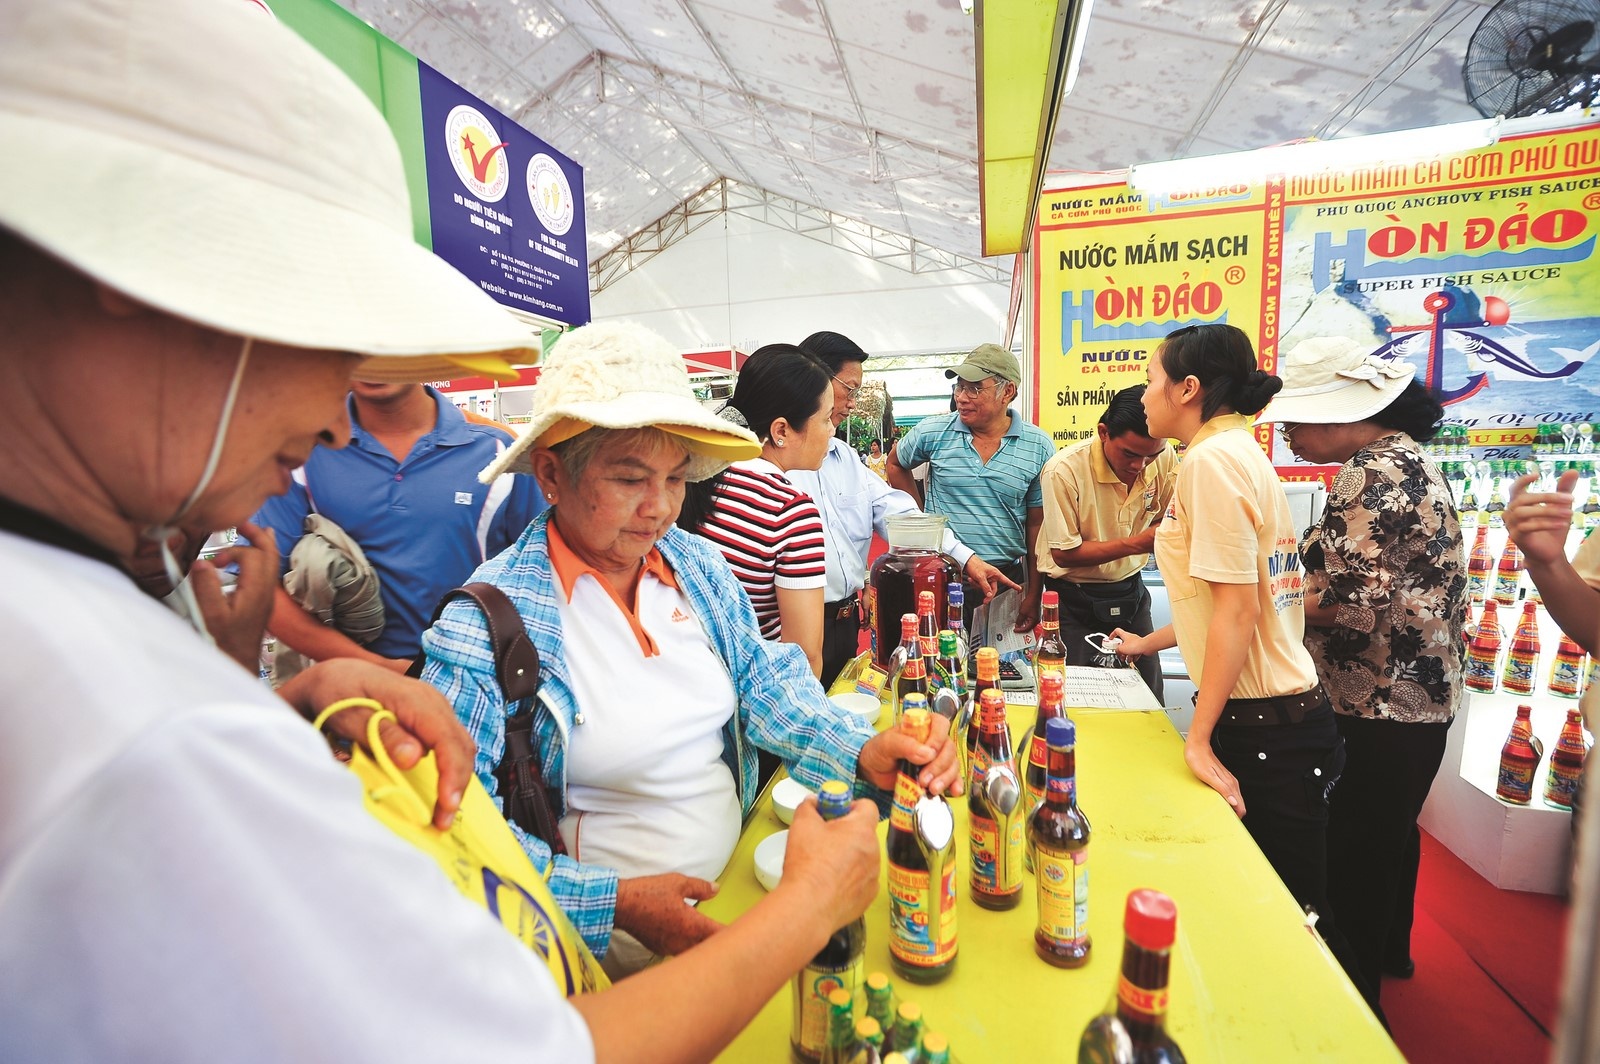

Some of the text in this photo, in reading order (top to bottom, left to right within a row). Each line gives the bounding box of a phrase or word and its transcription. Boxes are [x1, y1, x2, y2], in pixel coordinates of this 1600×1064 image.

[1291, 167, 1345, 197] NƯỚC
[1413, 154, 1442, 185] CÁ
[1448, 152, 1504, 181] CƠM
[1509, 138, 1558, 175] PHÚ
[1563, 138, 1600, 168] QU
[1051, 198, 1093, 211] NƯỚC
[1316, 178, 1600, 217] PHU QUOC ANCHOVY FISH SAUCE
[1051, 210, 1064, 219] CÁ
[1068, 208, 1090, 218] CƠM
[1267, 193, 1281, 258] NHIÊN
[1058, 233, 1248, 271] NƯỚC MẮM SẠCH
[1312, 214, 1449, 294] HÒN
[1464, 202, 1588, 250] ĐẢO
[1266, 263, 1281, 291] TỰ
[1343, 267, 1562, 295] SUPER FISH SAUCE
[480, 280, 564, 313] Website: www.kimhang.com.vn
[1061, 276, 1144, 356] HÒN
[1151, 271, 1223, 319] ĐẢO
[1264, 295, 1277, 340] CƠM
[1081, 363, 1141, 373] CÁ CƠM
[1082, 348, 1147, 363] NƯỚC
[1261, 345, 1274, 372] CÁ
[1056, 381, 1116, 406] SẢN PHẨM
[1053, 429, 1078, 441] KHÔNG
